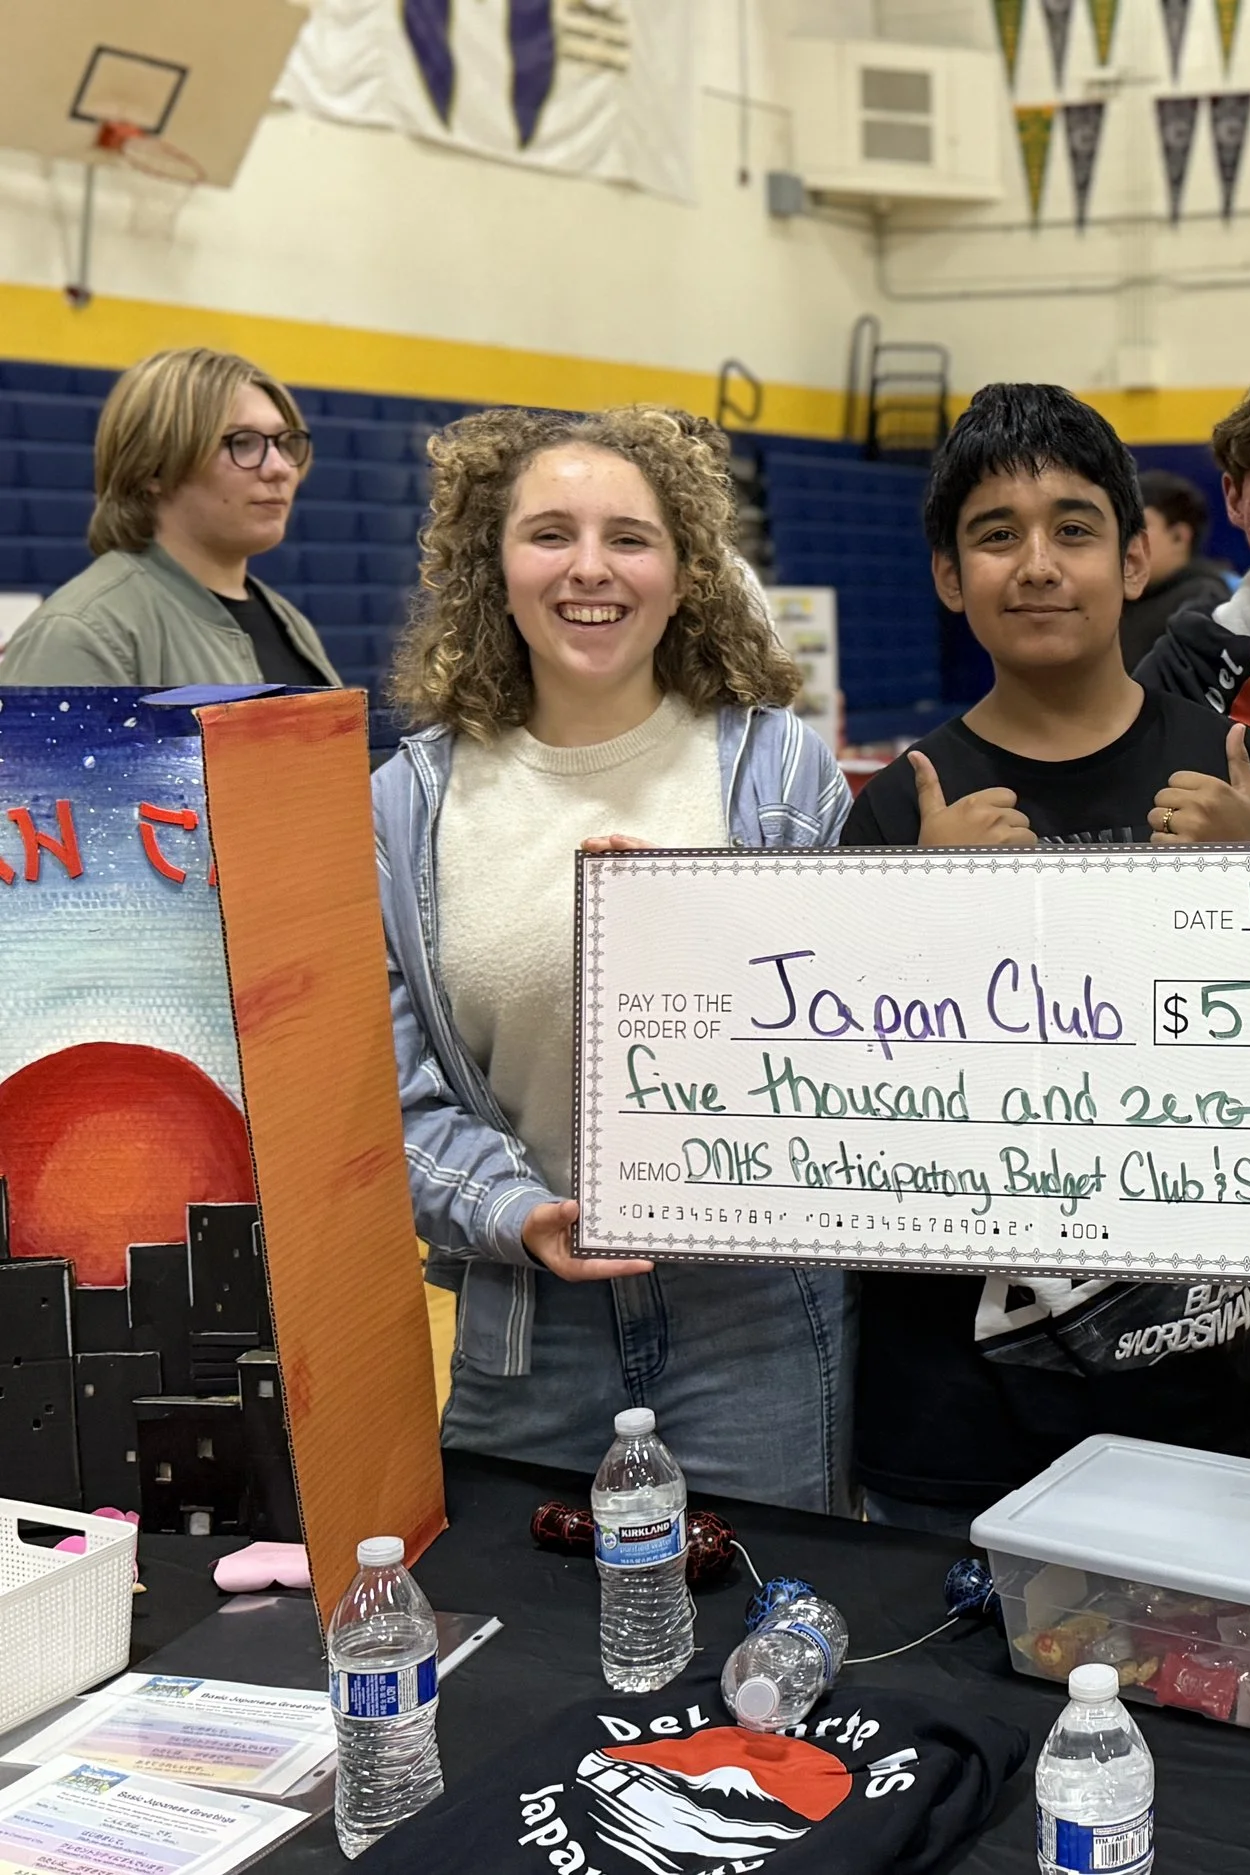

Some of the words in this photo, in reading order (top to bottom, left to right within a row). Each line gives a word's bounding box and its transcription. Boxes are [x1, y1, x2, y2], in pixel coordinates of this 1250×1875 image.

[1174, 910, 1234, 930] DATE
[618, 1021, 686, 1039] ORDER
[694, 1021, 721, 1039] OF
[749, 950, 966, 1060] Japan
[987, 958, 1123, 1043] Club
[619, 994, 654, 1012] PAY
[661, 994, 687, 1012] TO
[694, 994, 733, 1013] THE
[626, 1044, 727, 1111] five
[748, 1052, 970, 1121] thousand
[1001, 1070, 1097, 1126] and
[619, 1161, 681, 1183] MEMO
[788, 1136, 991, 1216] Participatory
[1000, 1147, 1106, 1217] Budget
[1120, 1150, 1205, 1204] Club
[621, 1522, 670, 1537] KIRKLAND
[201, 1692, 227, 1701] Basic
[229, 1696, 277, 1706] Japanese
[278, 1701, 327, 1712] Greetings
[596, 1704, 710, 1742] Del
[865, 1747, 919, 1798] HS
[117, 1791, 144, 1803] Basic
[143, 1797, 191, 1816] Japanese
[189, 1807, 237, 1825] Greetings
